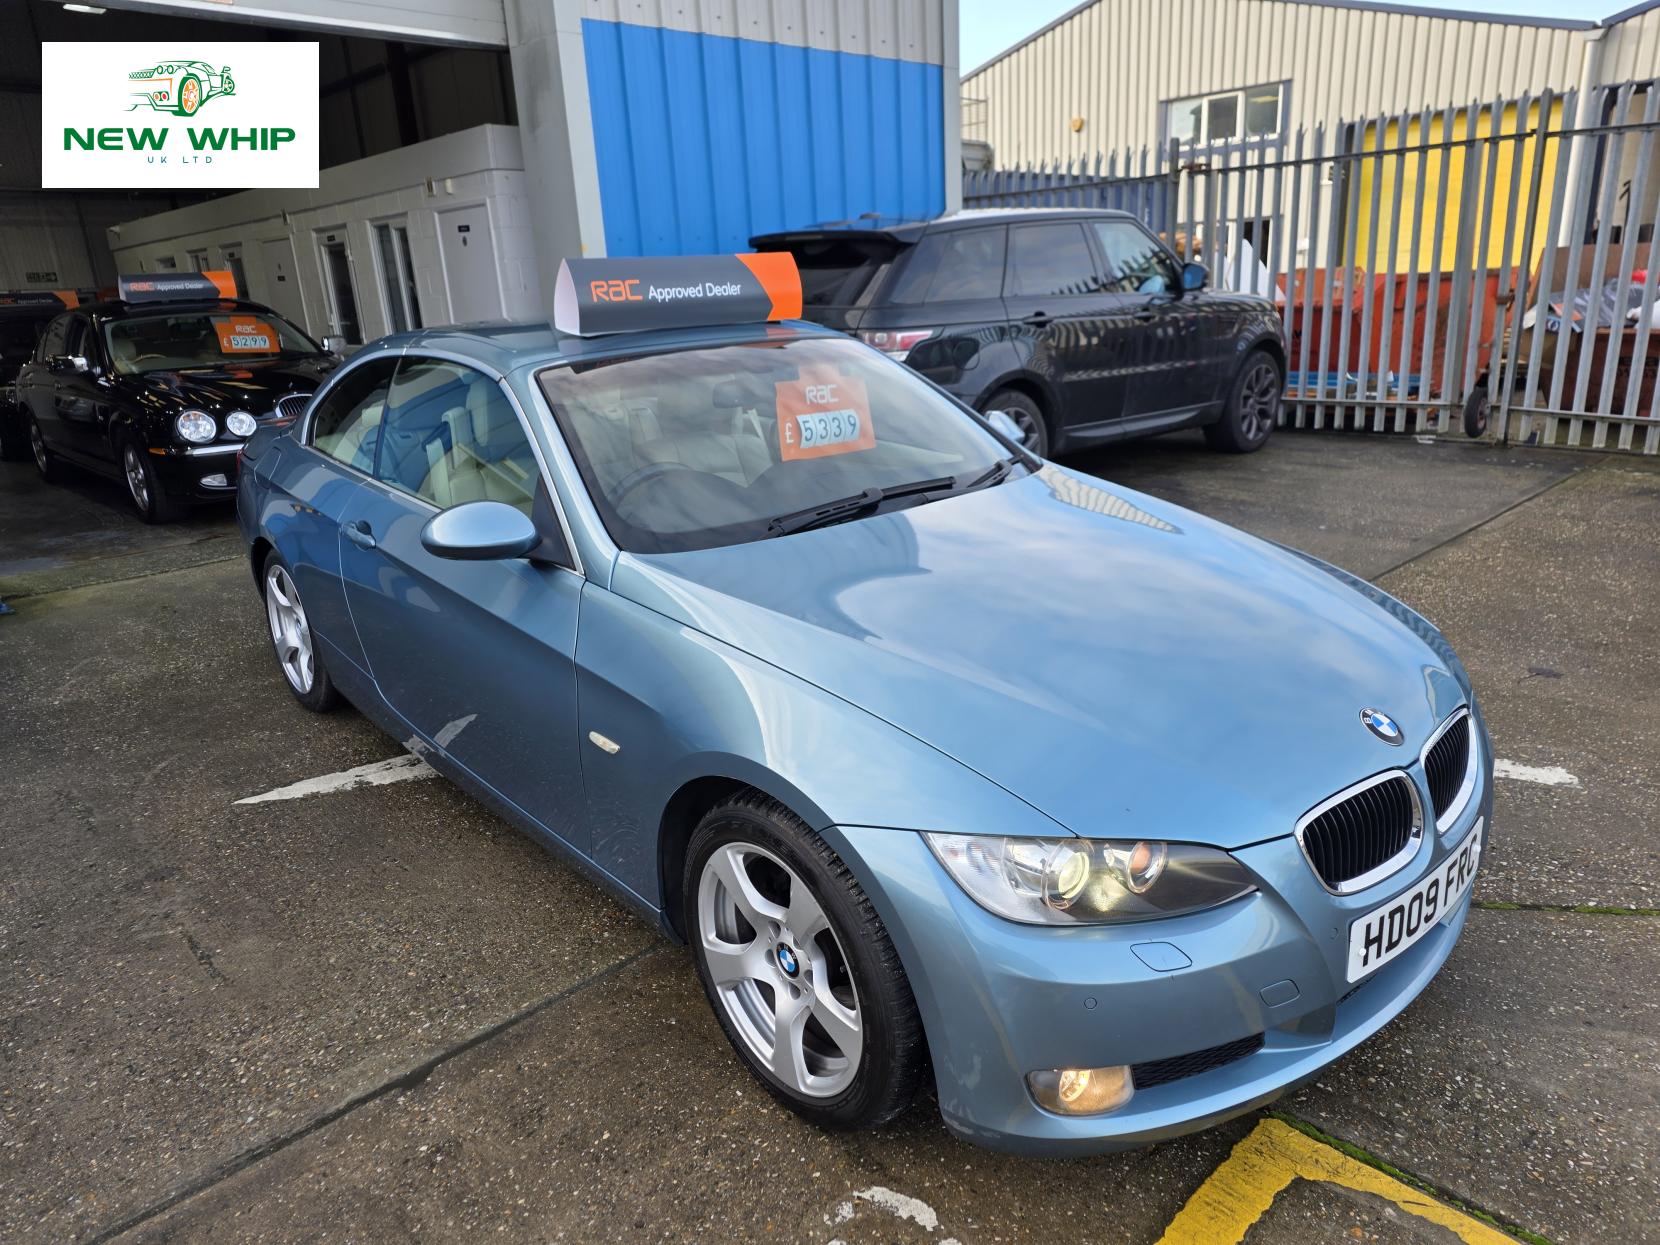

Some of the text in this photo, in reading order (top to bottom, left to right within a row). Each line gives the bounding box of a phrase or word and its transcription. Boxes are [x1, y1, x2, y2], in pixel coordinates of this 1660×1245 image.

[157, 281, 185, 292] Approved
[648, 282, 704, 303] Approved
[706, 282, 742, 297] Dealer
[232, 336, 267, 347] 5299
[784, 414, 857, 444] £ 5339
[1362, 833, 1478, 967] HD09 FRC
